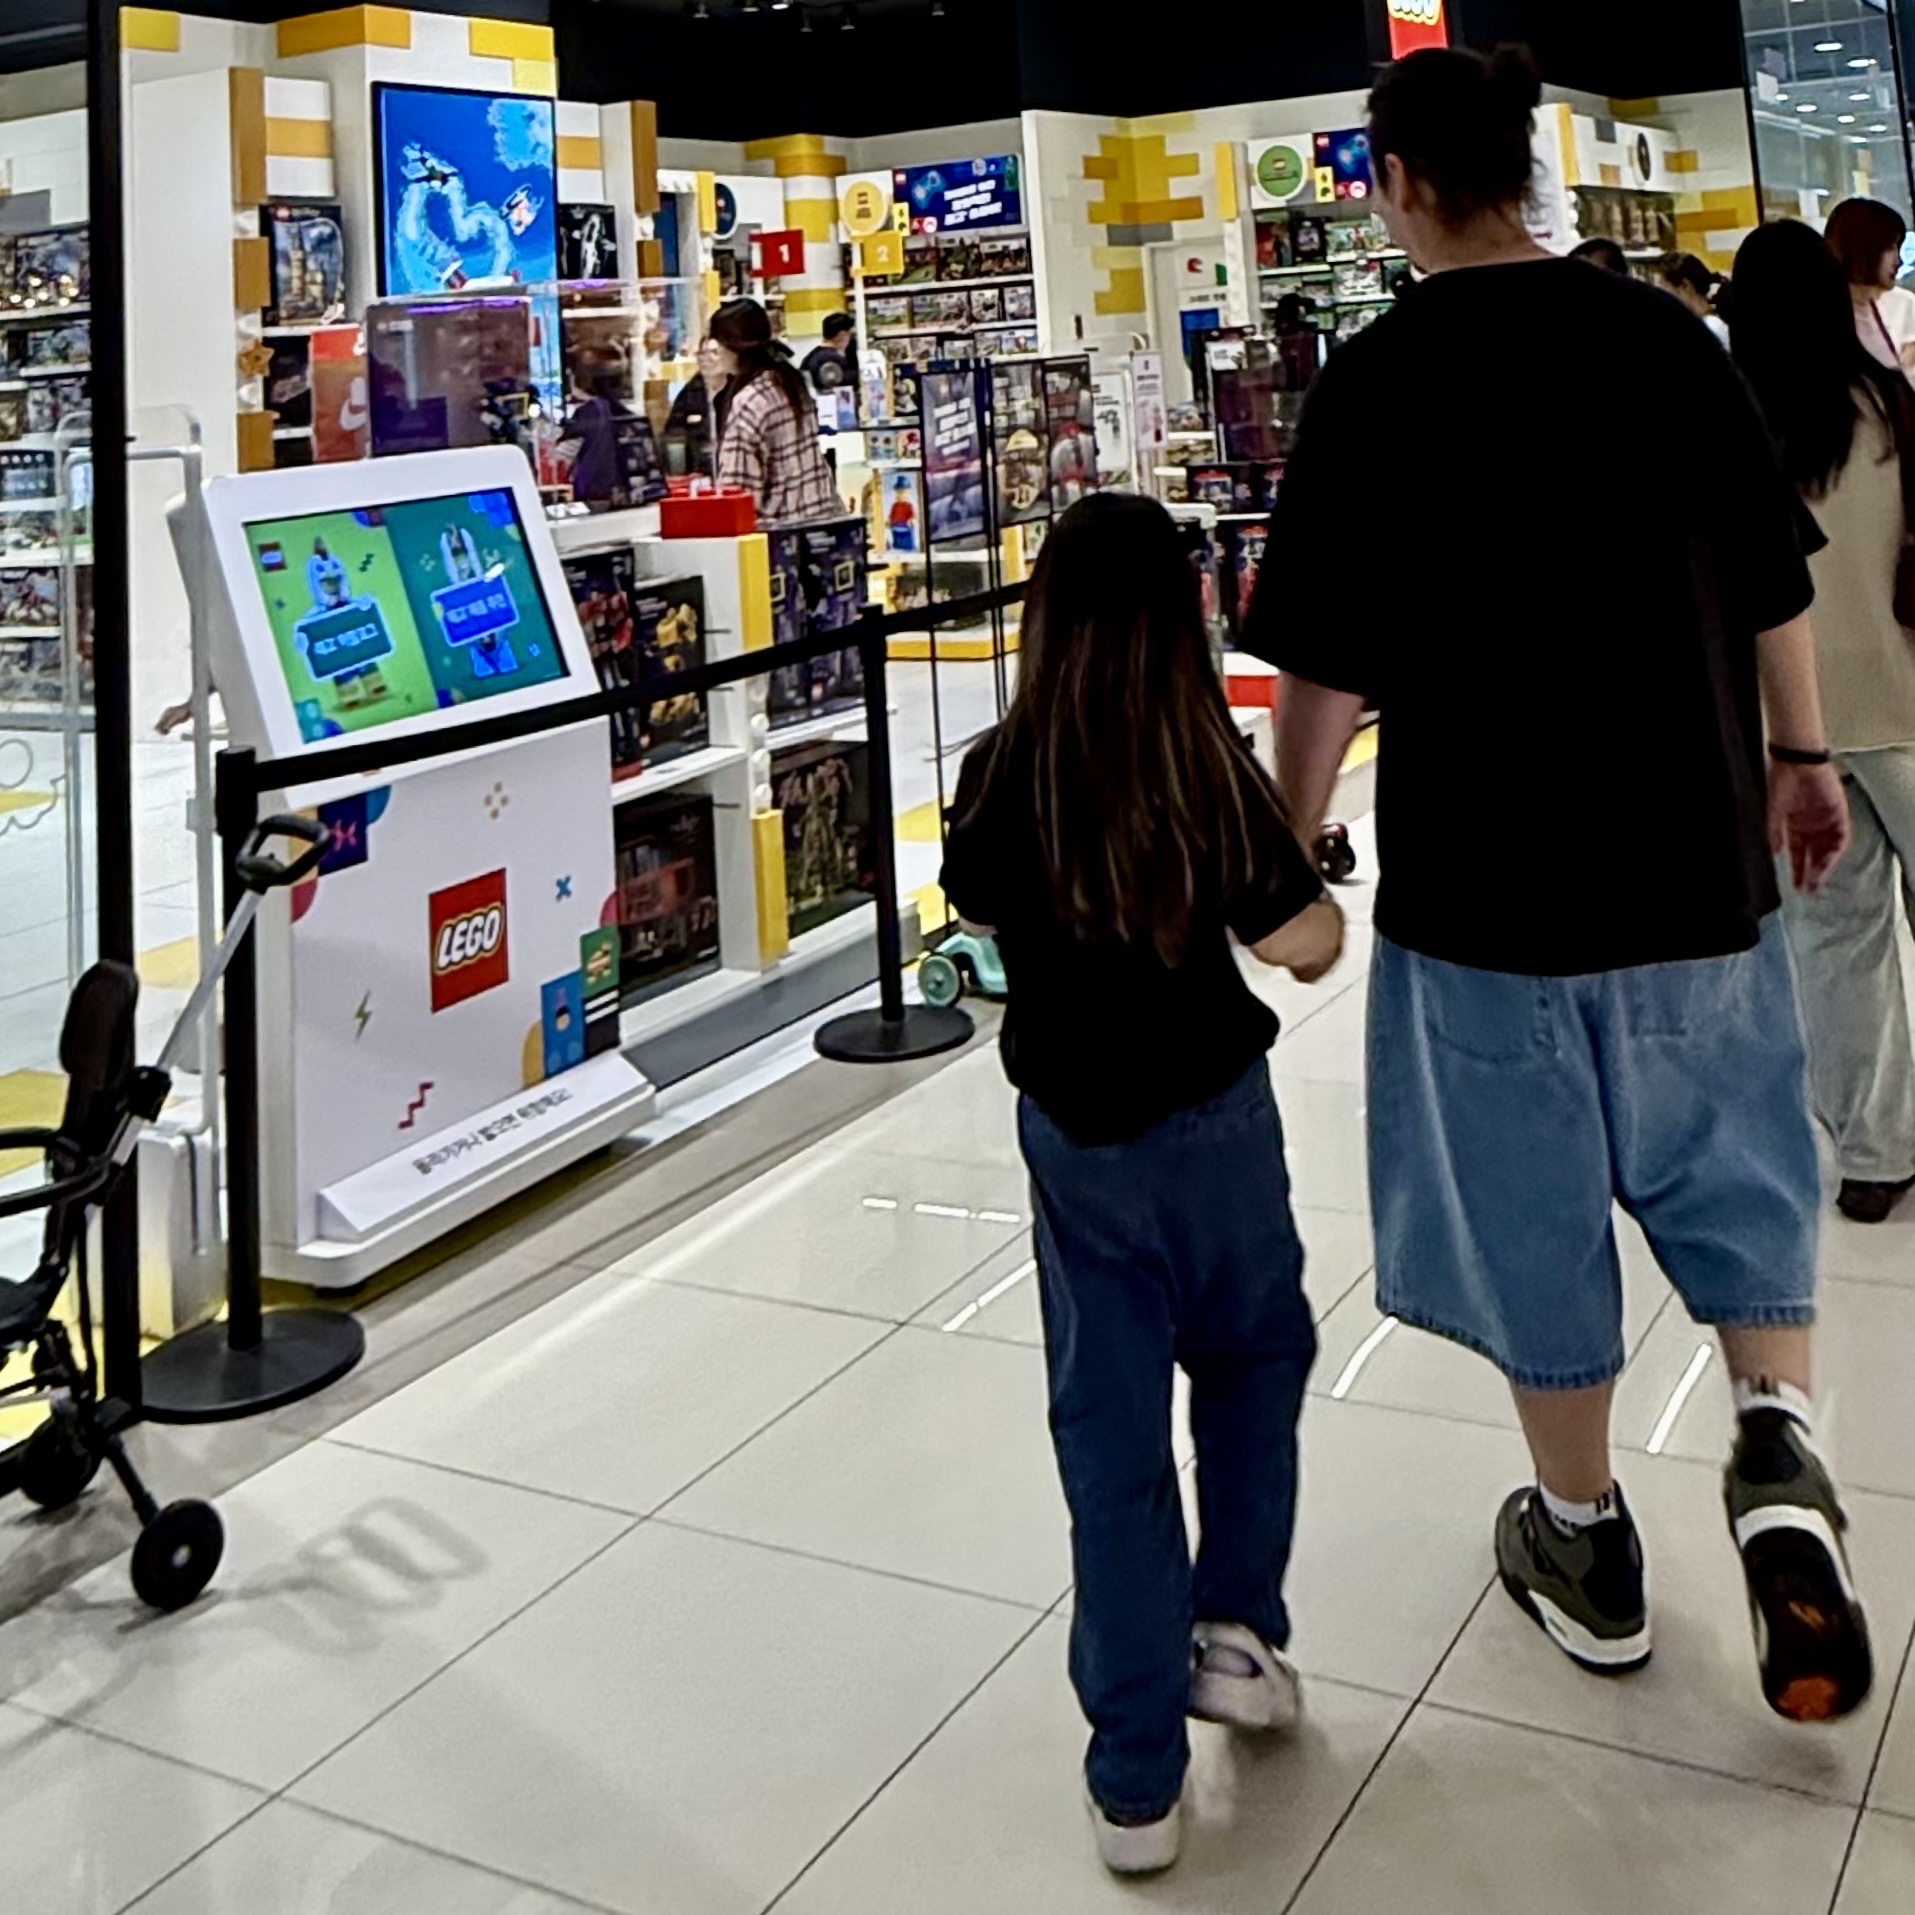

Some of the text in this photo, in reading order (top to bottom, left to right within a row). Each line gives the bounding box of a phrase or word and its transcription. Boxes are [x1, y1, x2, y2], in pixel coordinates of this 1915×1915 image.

[779, 244, 790, 263] 1
[877, 245, 889, 262] 2
[437, 909, 501, 969] LEGO
